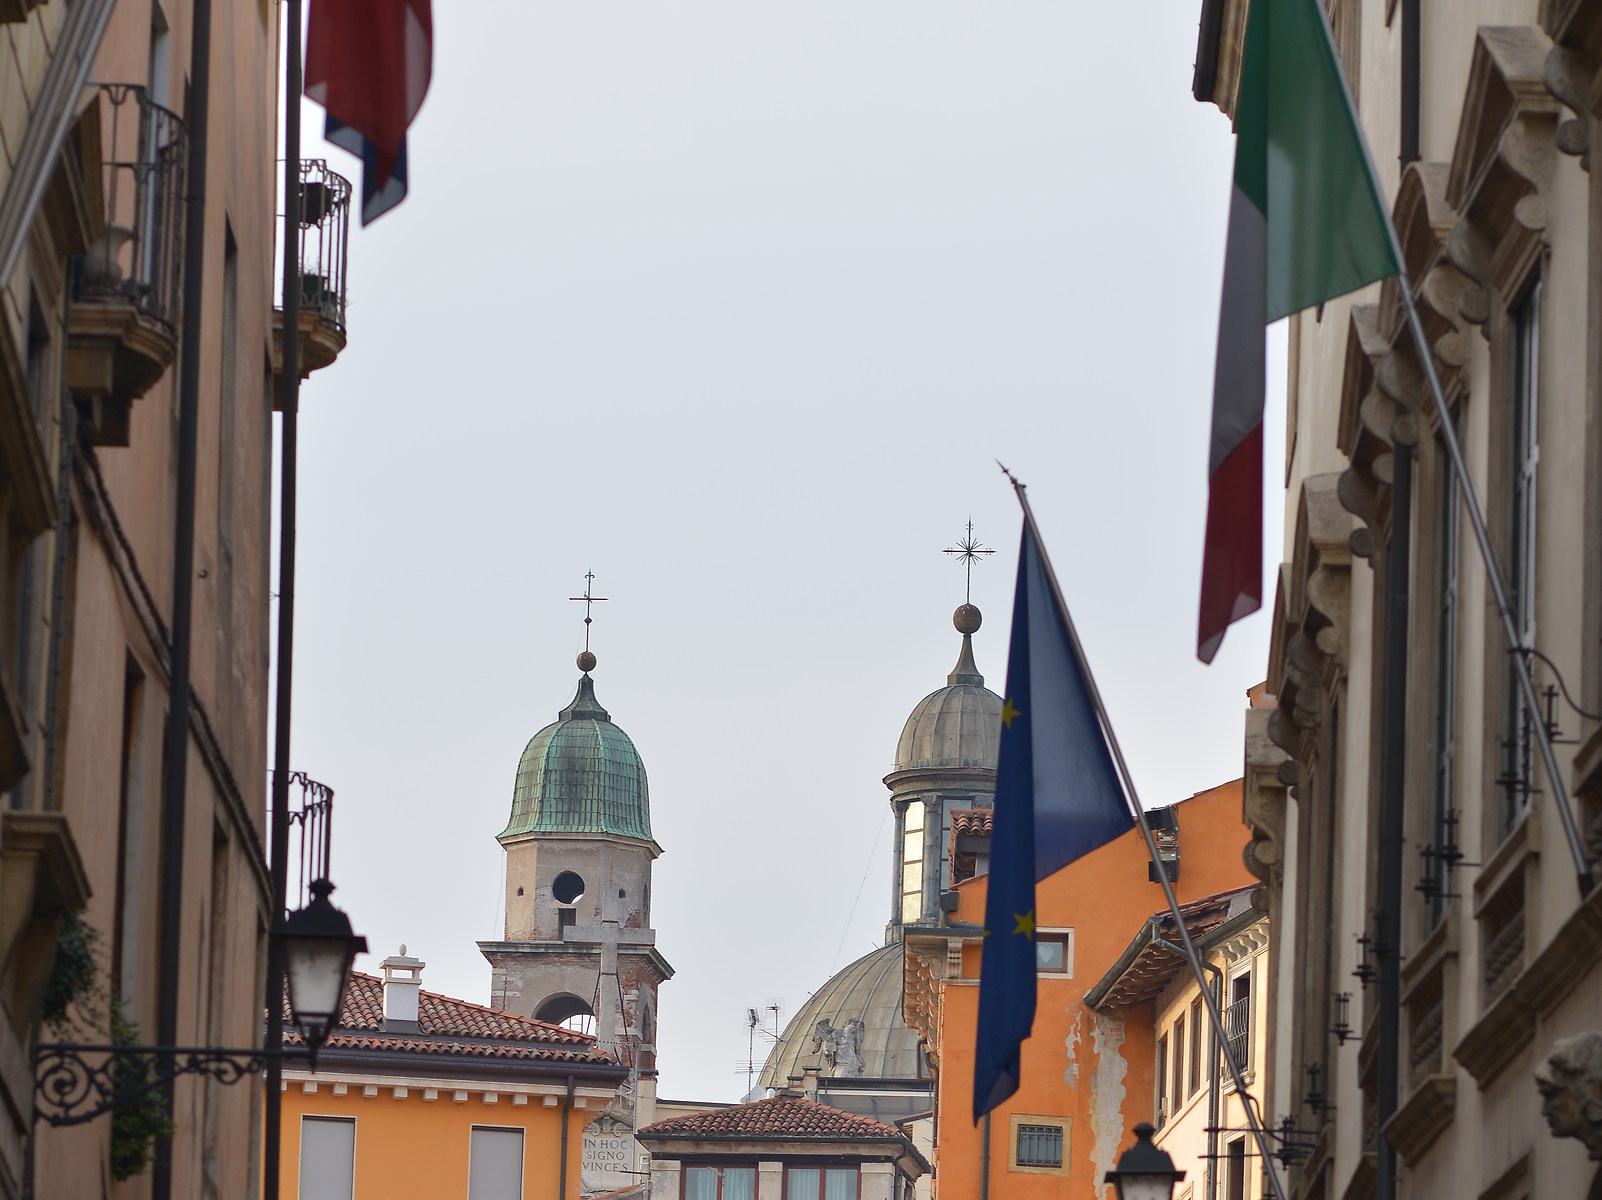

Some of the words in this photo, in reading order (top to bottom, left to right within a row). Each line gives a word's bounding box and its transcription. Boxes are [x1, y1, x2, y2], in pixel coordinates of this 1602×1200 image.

[584, 1139, 596, 1149] IN
[600, 1139, 628, 1150] HOC
[586, 1150, 625, 1161] SIGNO
[582, 1161, 628, 1172] VINCES
